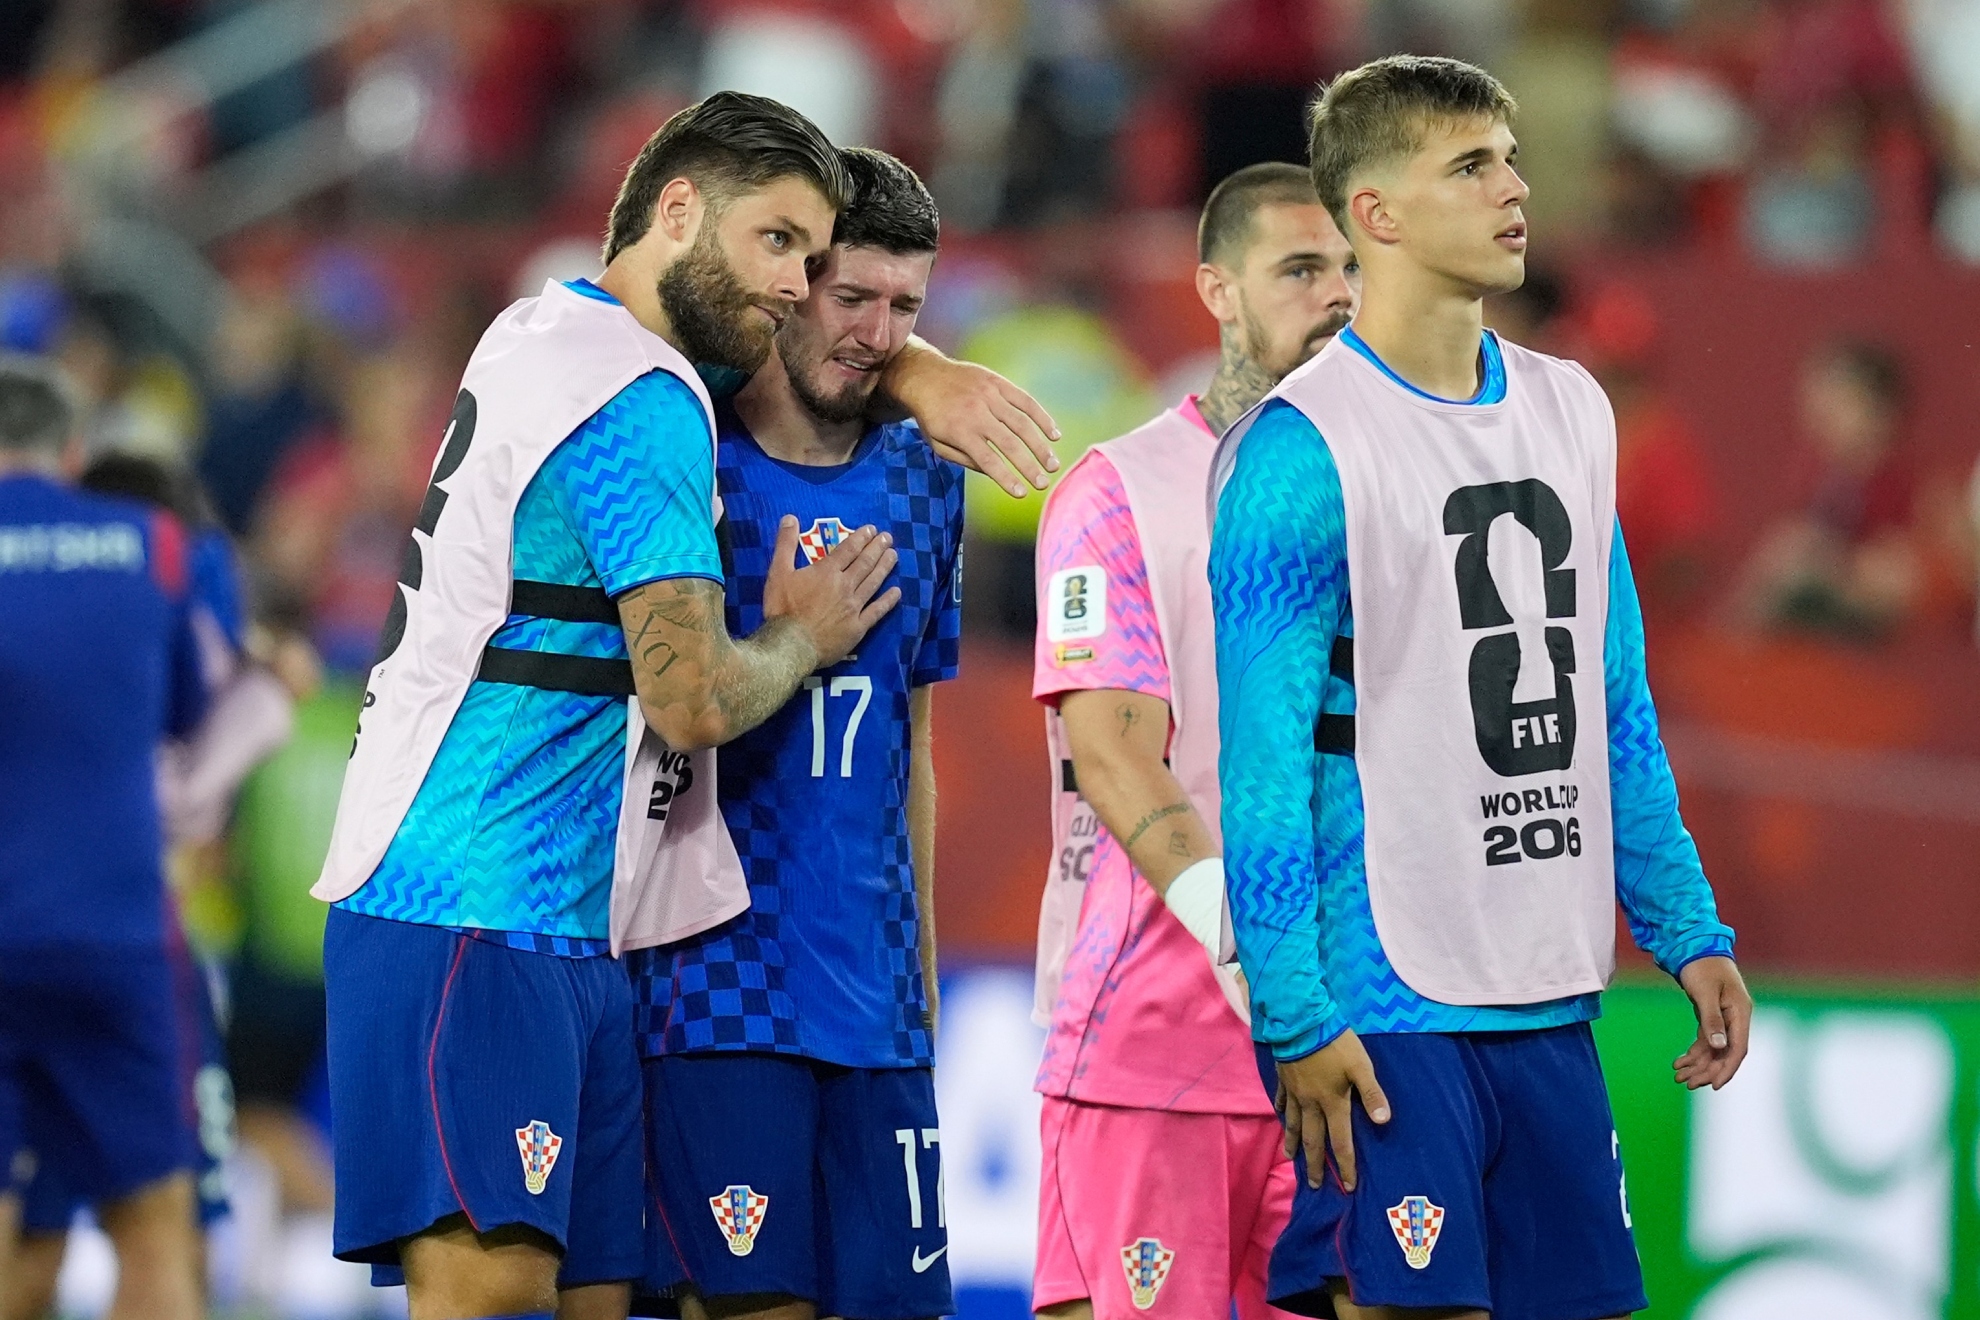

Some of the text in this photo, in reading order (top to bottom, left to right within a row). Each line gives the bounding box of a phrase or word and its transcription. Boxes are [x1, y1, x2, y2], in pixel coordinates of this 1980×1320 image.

[804, 675, 873, 777] 17
[1511, 713, 1562, 749] FIF
[1480, 786, 1560, 819] WORL
[1483, 817, 1581, 866] 206
[895, 1128, 945, 1229] 17
